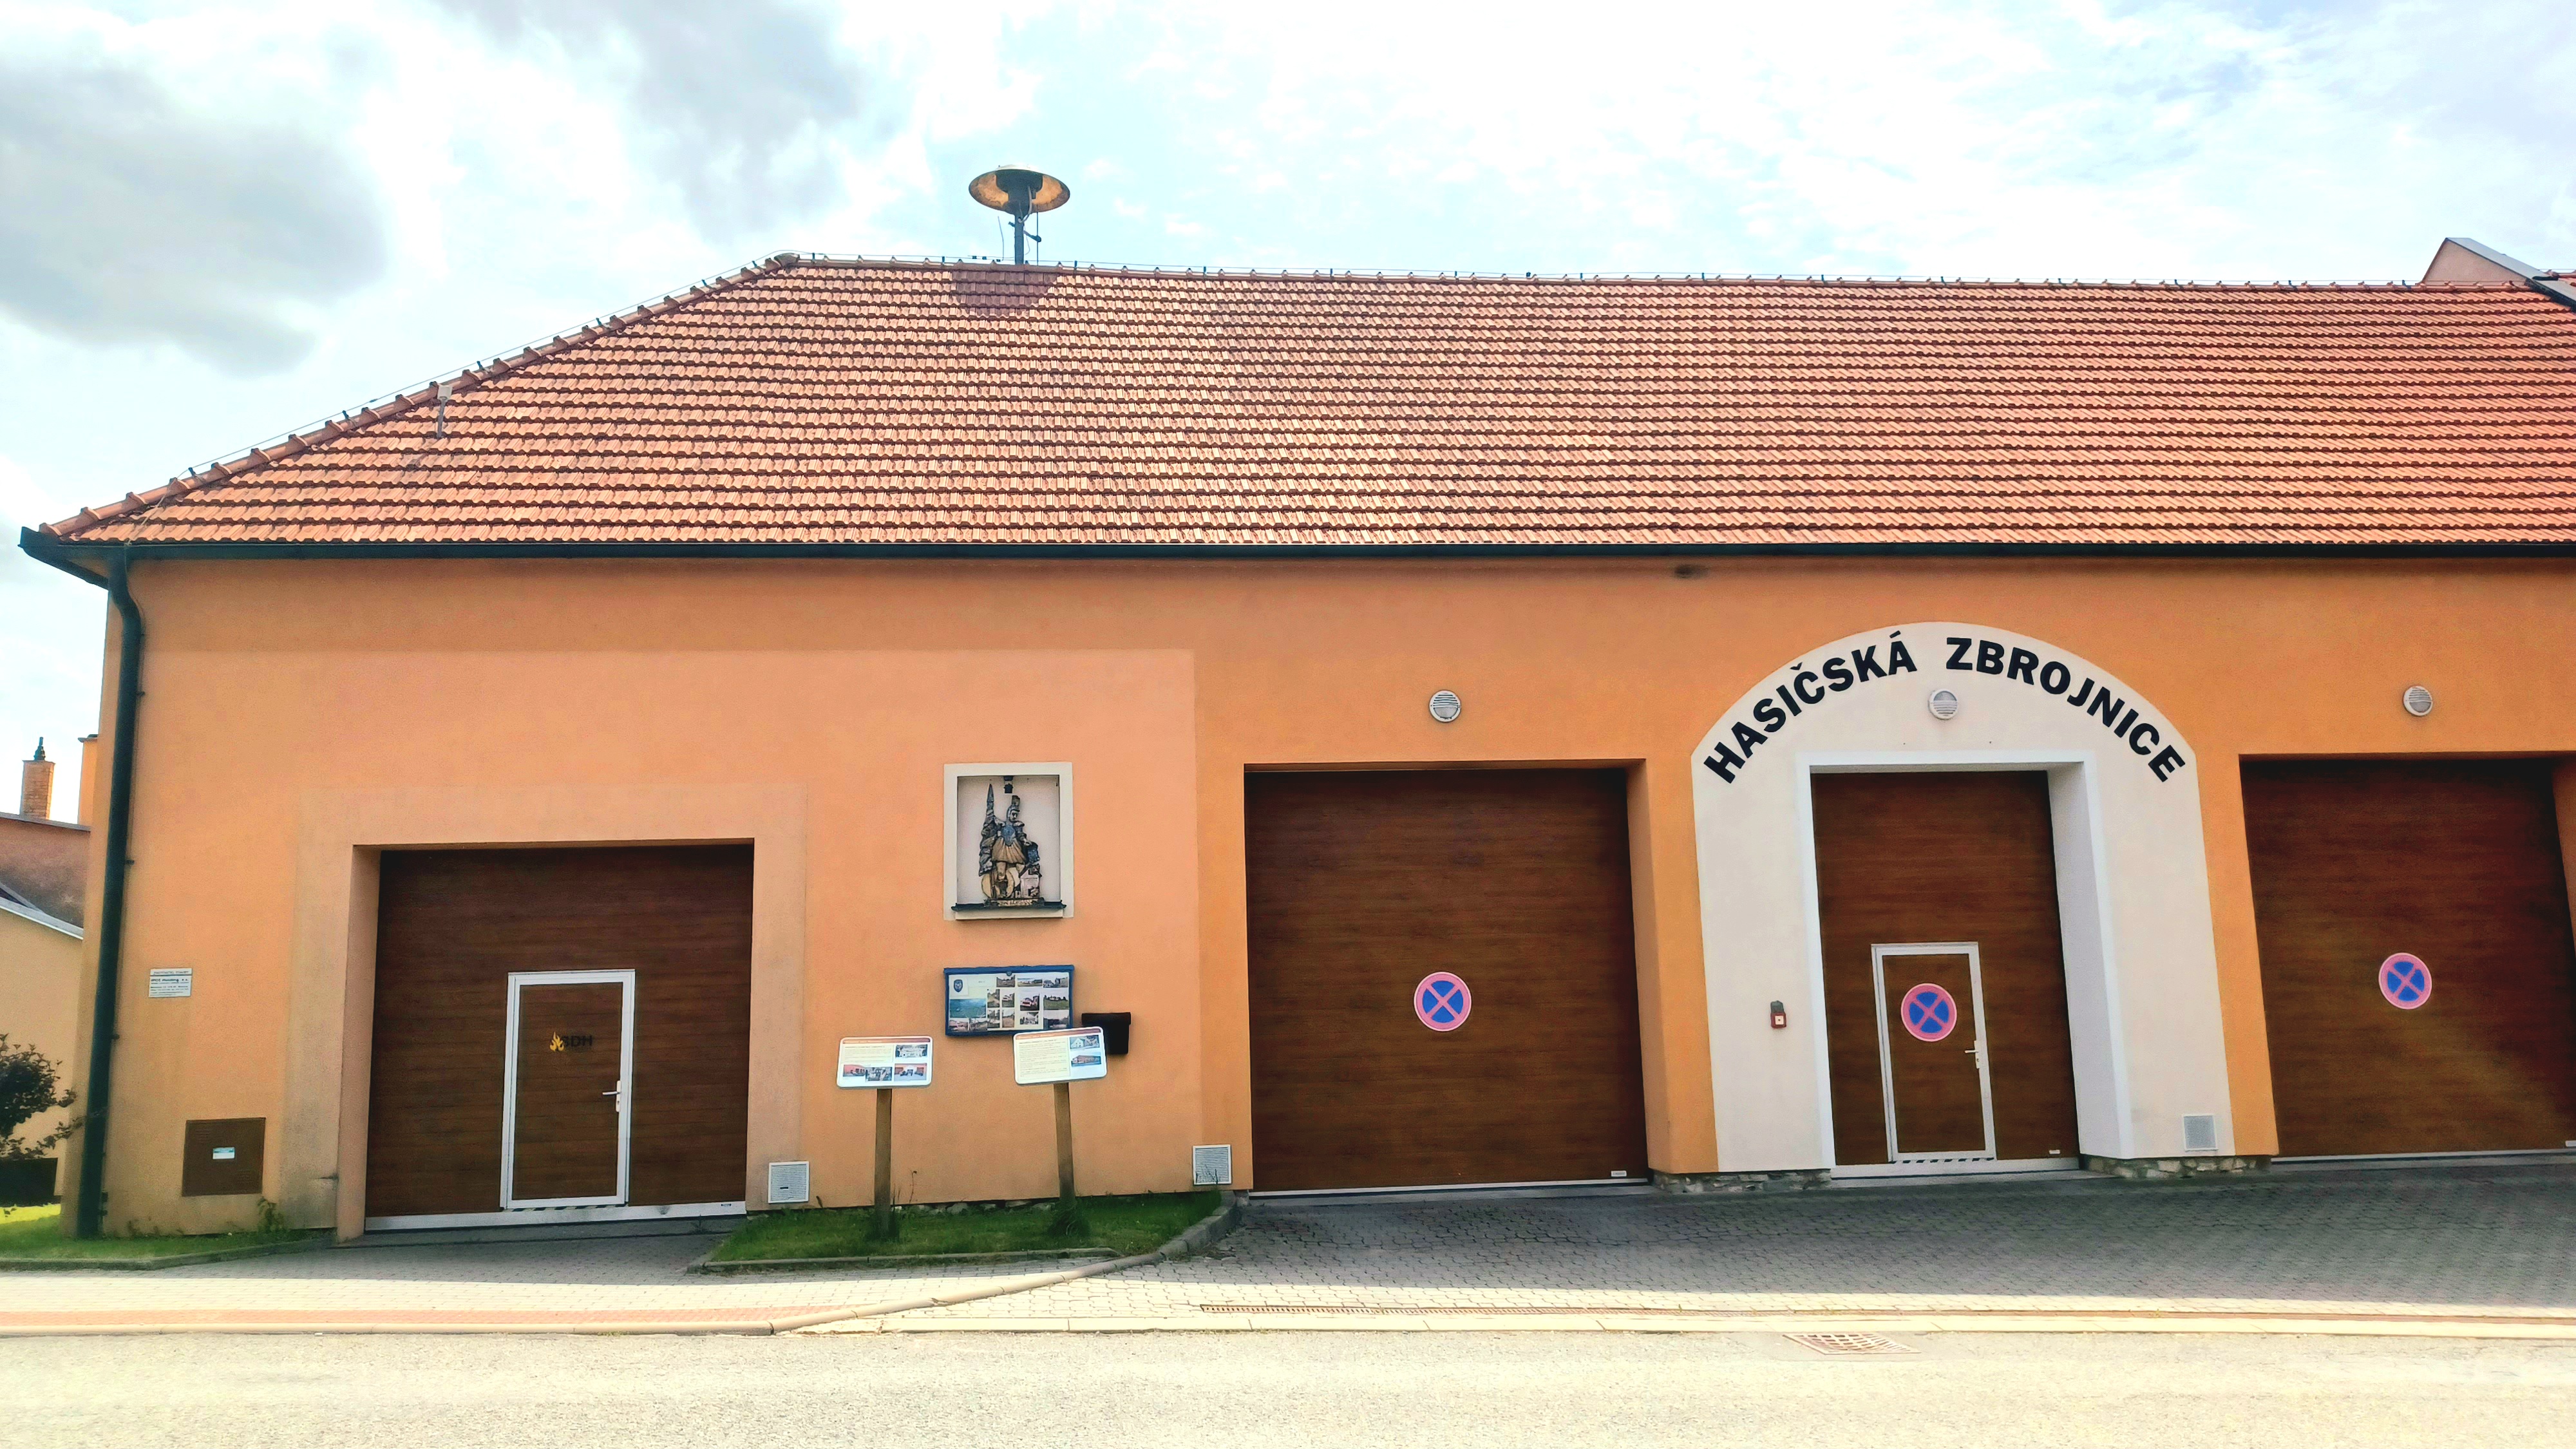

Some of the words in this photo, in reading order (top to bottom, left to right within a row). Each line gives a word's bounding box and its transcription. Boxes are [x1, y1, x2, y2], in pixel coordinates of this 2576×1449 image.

[1704, 631, 1917, 783] HASIČSKÁ
[1946, 638, 2185, 782] ZBROJNICE
[562, 1036, 592, 1046] SDH
